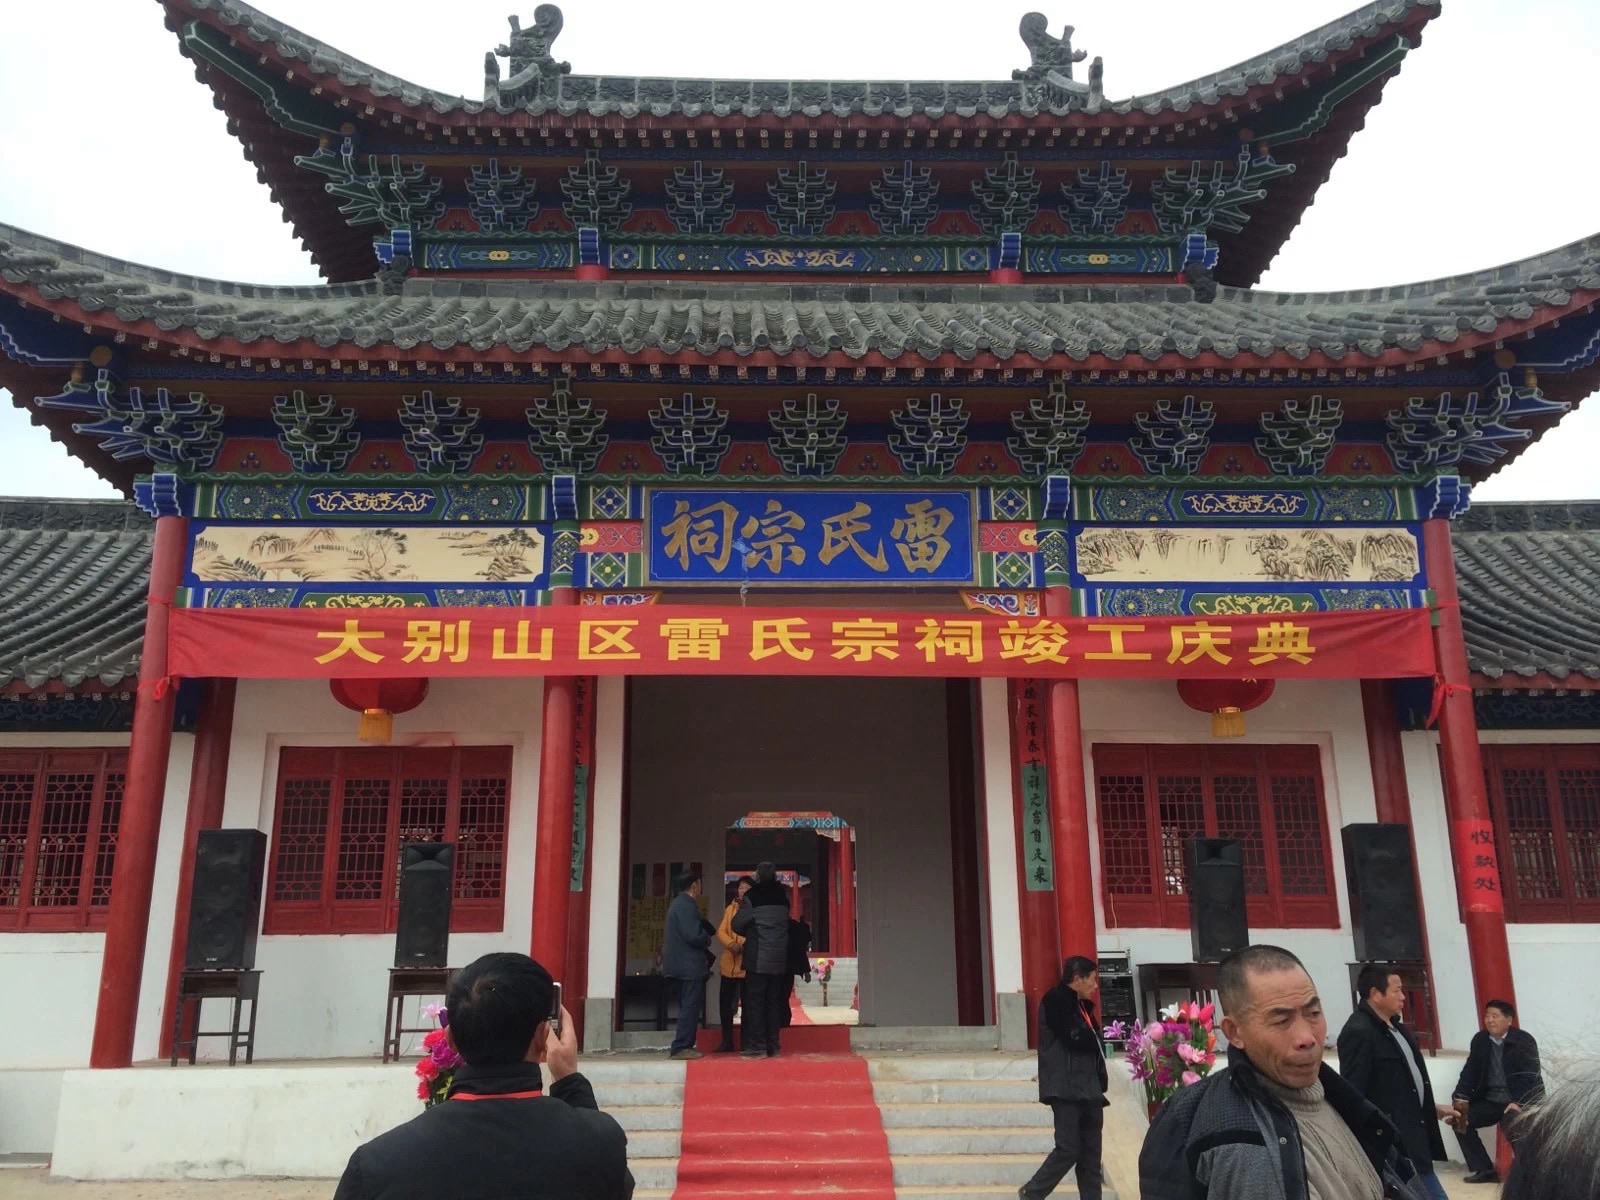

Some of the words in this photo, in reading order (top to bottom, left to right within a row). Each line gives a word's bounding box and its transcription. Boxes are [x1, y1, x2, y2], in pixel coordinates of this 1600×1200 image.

[661, 499, 955, 573] 雷氏宗祠
[314, 617, 1318, 665] 大别山区雷氏宗祠竣工庆典
